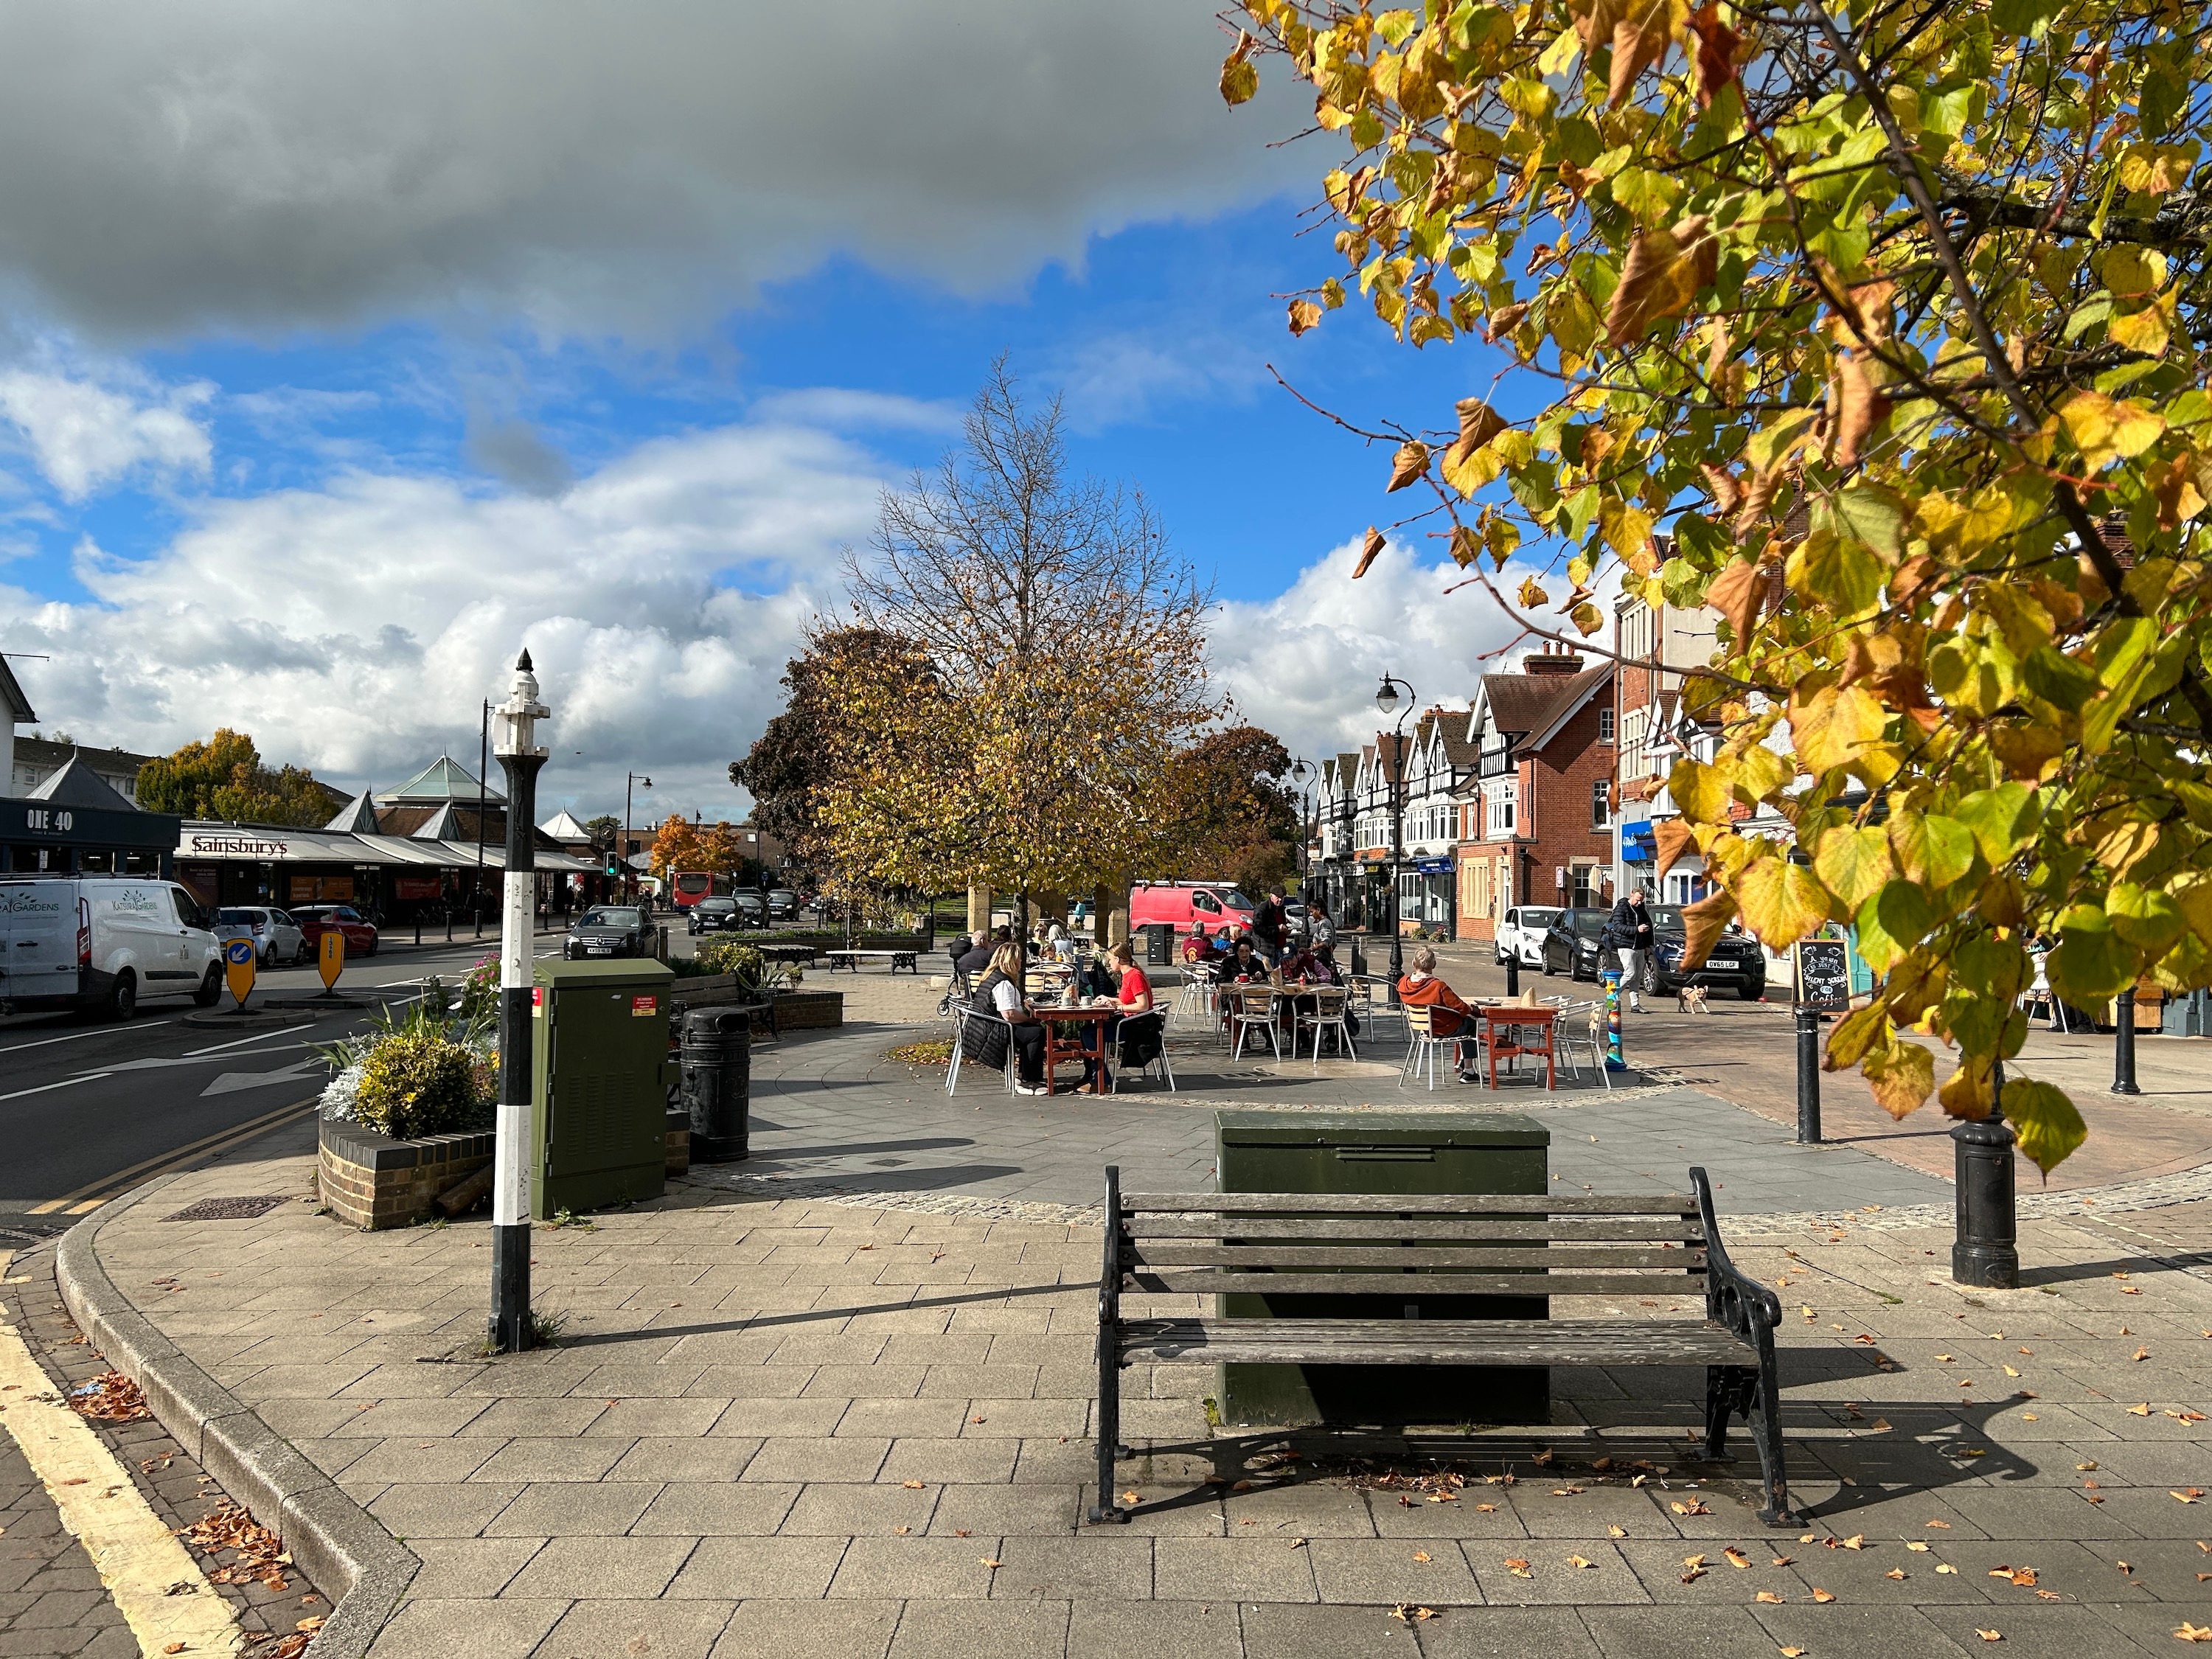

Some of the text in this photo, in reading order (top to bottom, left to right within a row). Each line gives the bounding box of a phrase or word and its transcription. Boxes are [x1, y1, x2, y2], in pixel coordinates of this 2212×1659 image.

[27, 809, 72, 831] ONE 40
[192, 837, 288, 855] Sainsbury's
[13, 902, 59, 912] GARDENS
[111, 900, 157, 911] KATSURA GARDENS
[1804, 975, 1825, 984] SILENT
[1810, 991, 1843, 1006] Coffee
